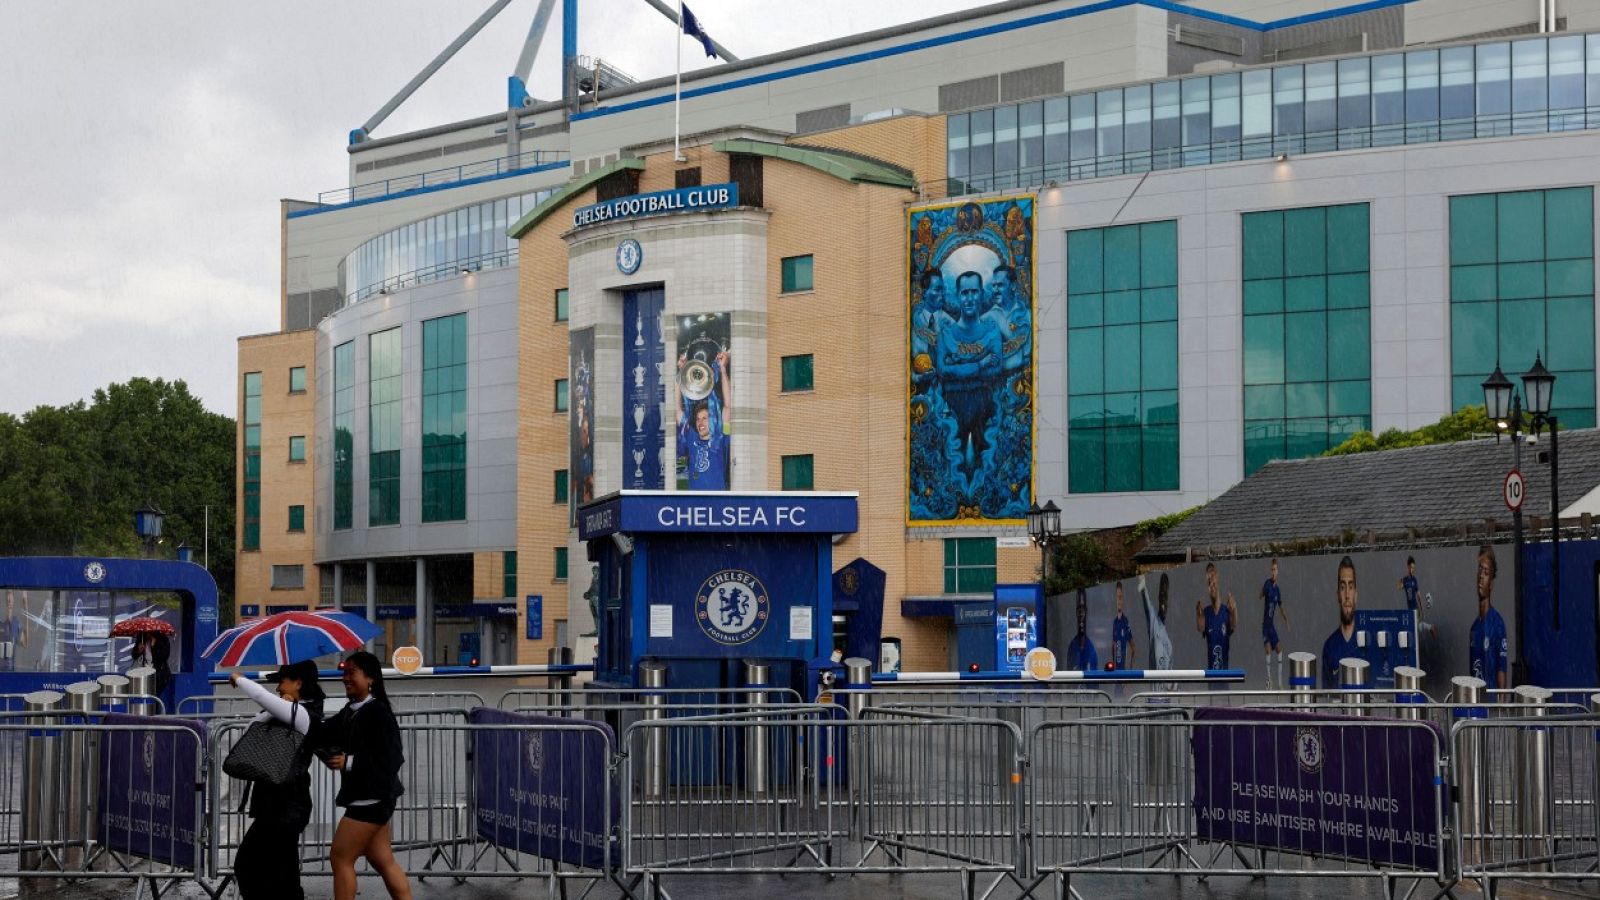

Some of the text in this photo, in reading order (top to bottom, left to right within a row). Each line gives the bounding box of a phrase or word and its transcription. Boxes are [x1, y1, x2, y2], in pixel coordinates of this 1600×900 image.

[574, 188, 729, 227] CHELSEA FOOTBALL CLUB
[1509, 481, 1520, 499] 10
[658, 506, 806, 526] CHELSEA FC
[708, 572, 756, 589] CHELSEA
[708, 627, 739, 641] FOOTBALL
[528, 791, 548, 809] YOUR
[1232, 782, 1399, 813] PLEASE WASH YOUR HANDS
[558, 826, 568, 841] T
[584, 831, 607, 849] TIME
[1201, 806, 1438, 849] AND USE SANITISER WHERE AVAILABLE
